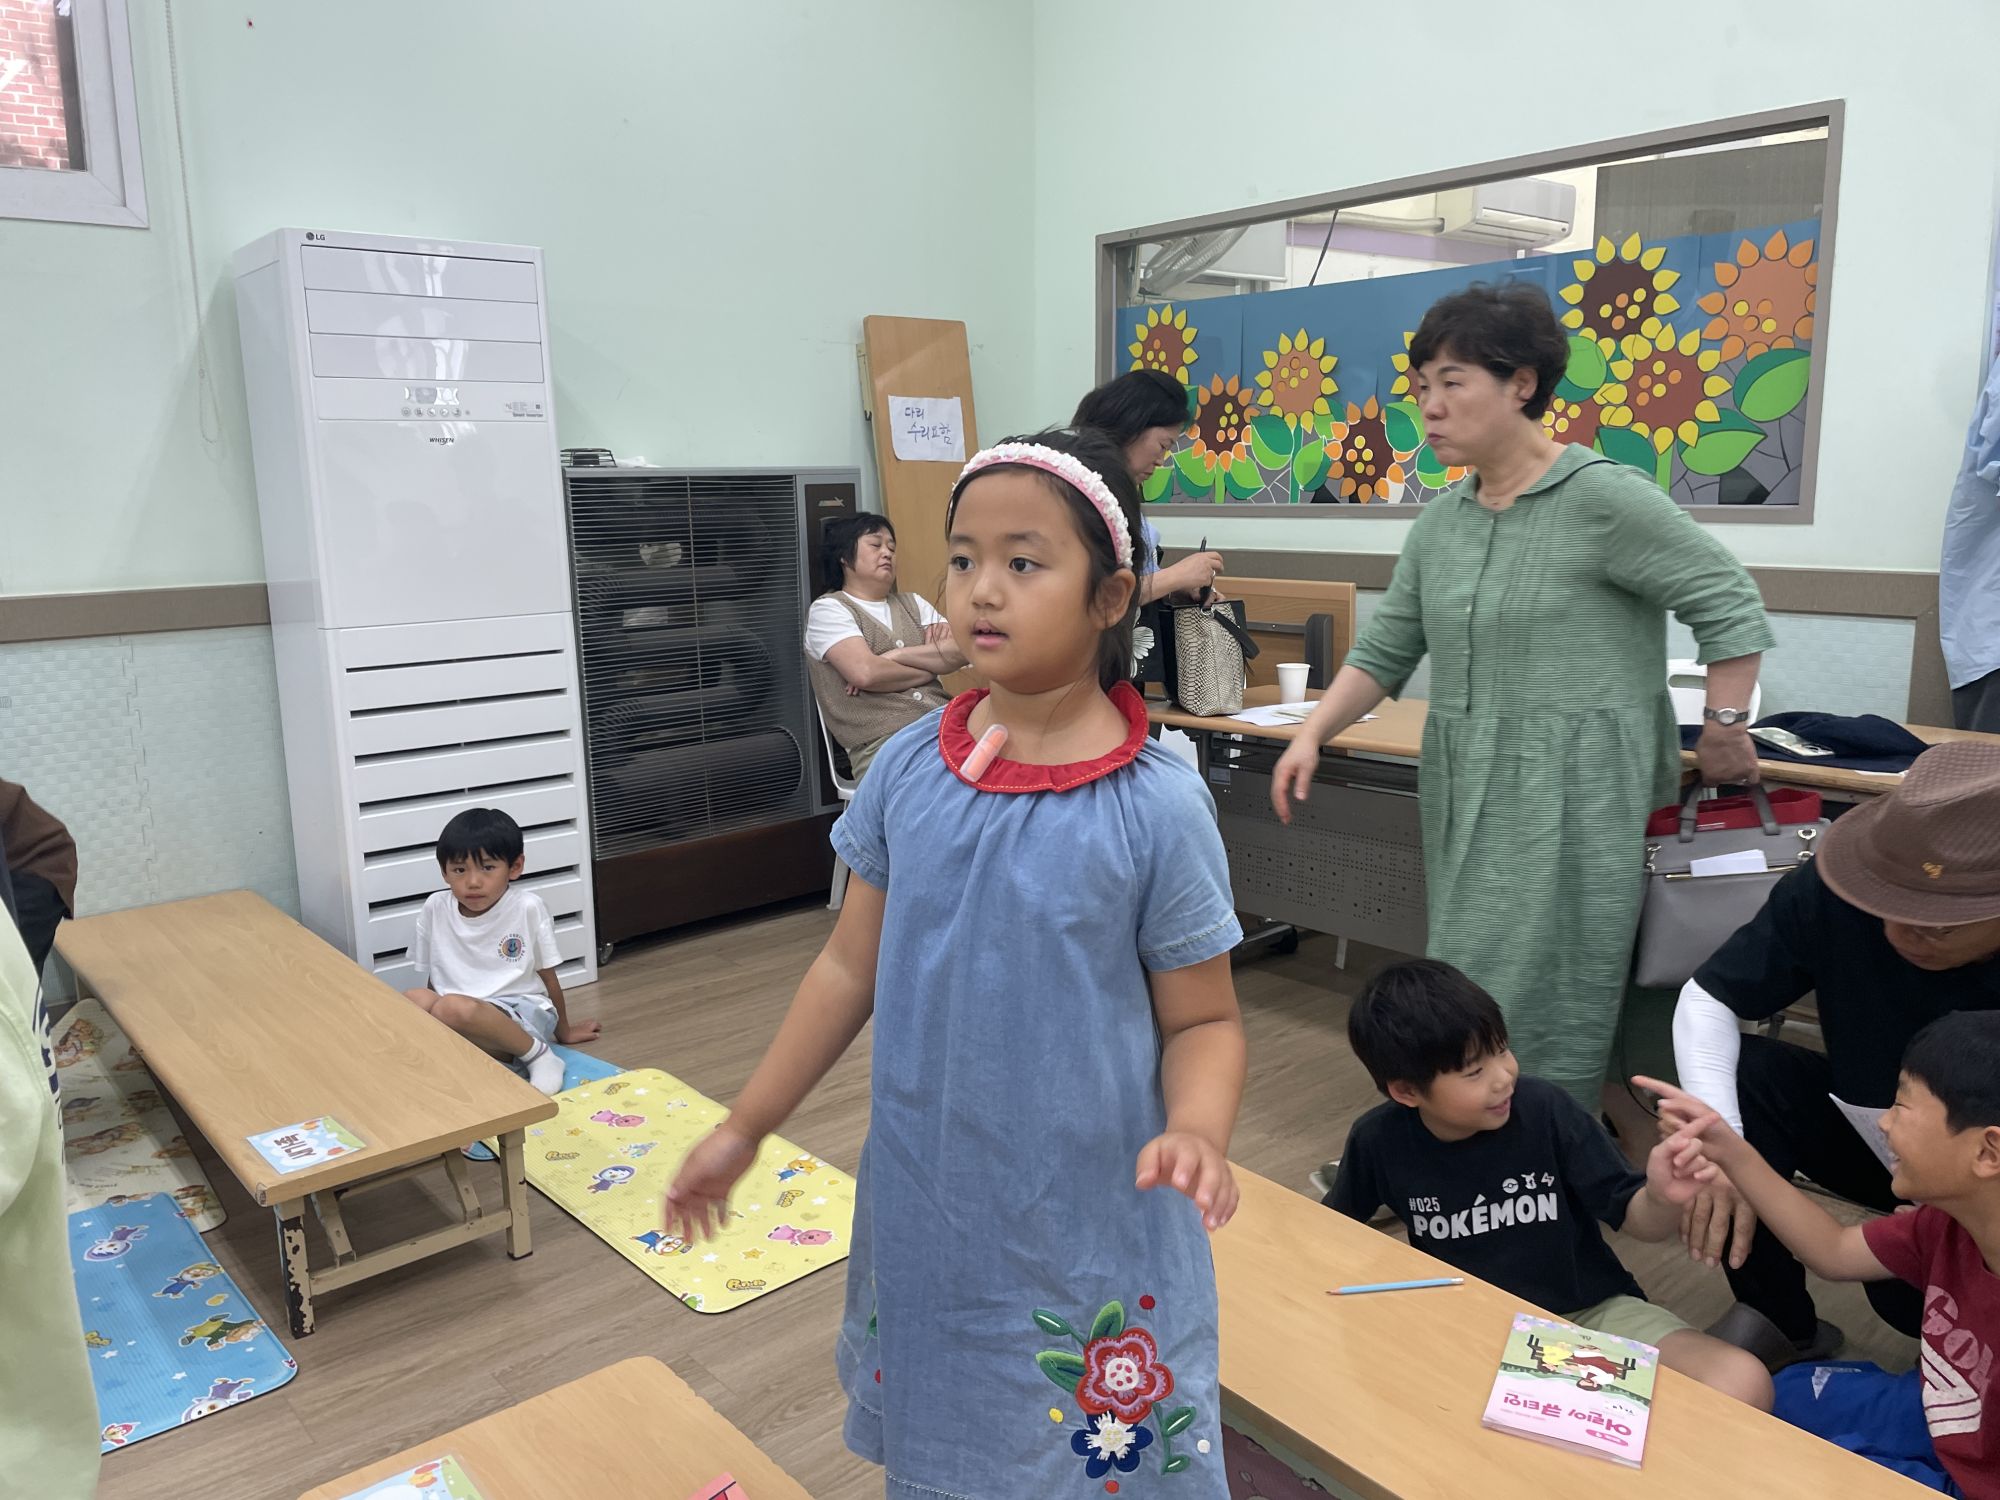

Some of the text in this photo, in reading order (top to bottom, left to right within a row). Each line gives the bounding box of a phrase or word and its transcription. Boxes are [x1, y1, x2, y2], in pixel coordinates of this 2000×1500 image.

[904, 406, 925, 420] 다리
[429, 437, 455, 446] WHISEN
[273, 1133, 317, 1160] 새가족
[1409, 1197, 1441, 1213] #025
[1413, 1193, 1558, 1240] POKÉMON
[1503, 1392, 1562, 1418] 큐티인
[1568, 1409, 1632, 1436] 어린이
